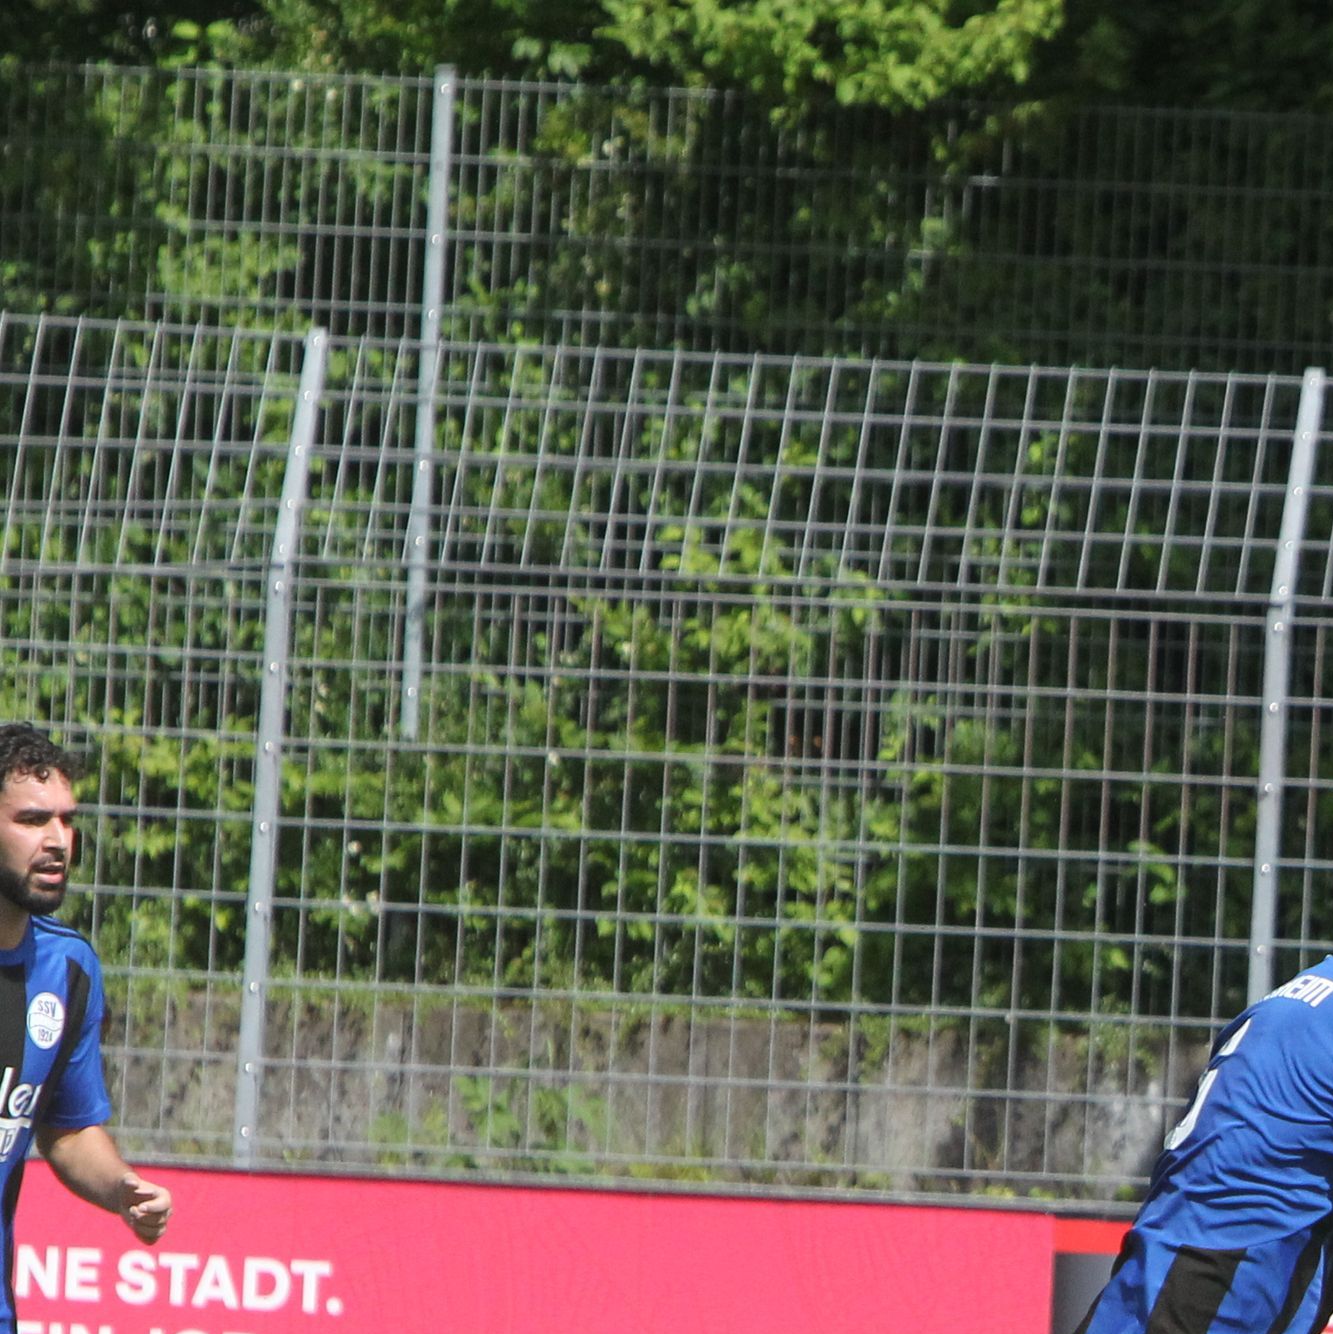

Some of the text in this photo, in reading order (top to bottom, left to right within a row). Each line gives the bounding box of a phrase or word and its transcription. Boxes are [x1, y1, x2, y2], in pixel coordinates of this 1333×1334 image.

[37, 1000, 57, 1018] SSV
[15, 1244, 344, 1317] NE STADT.
